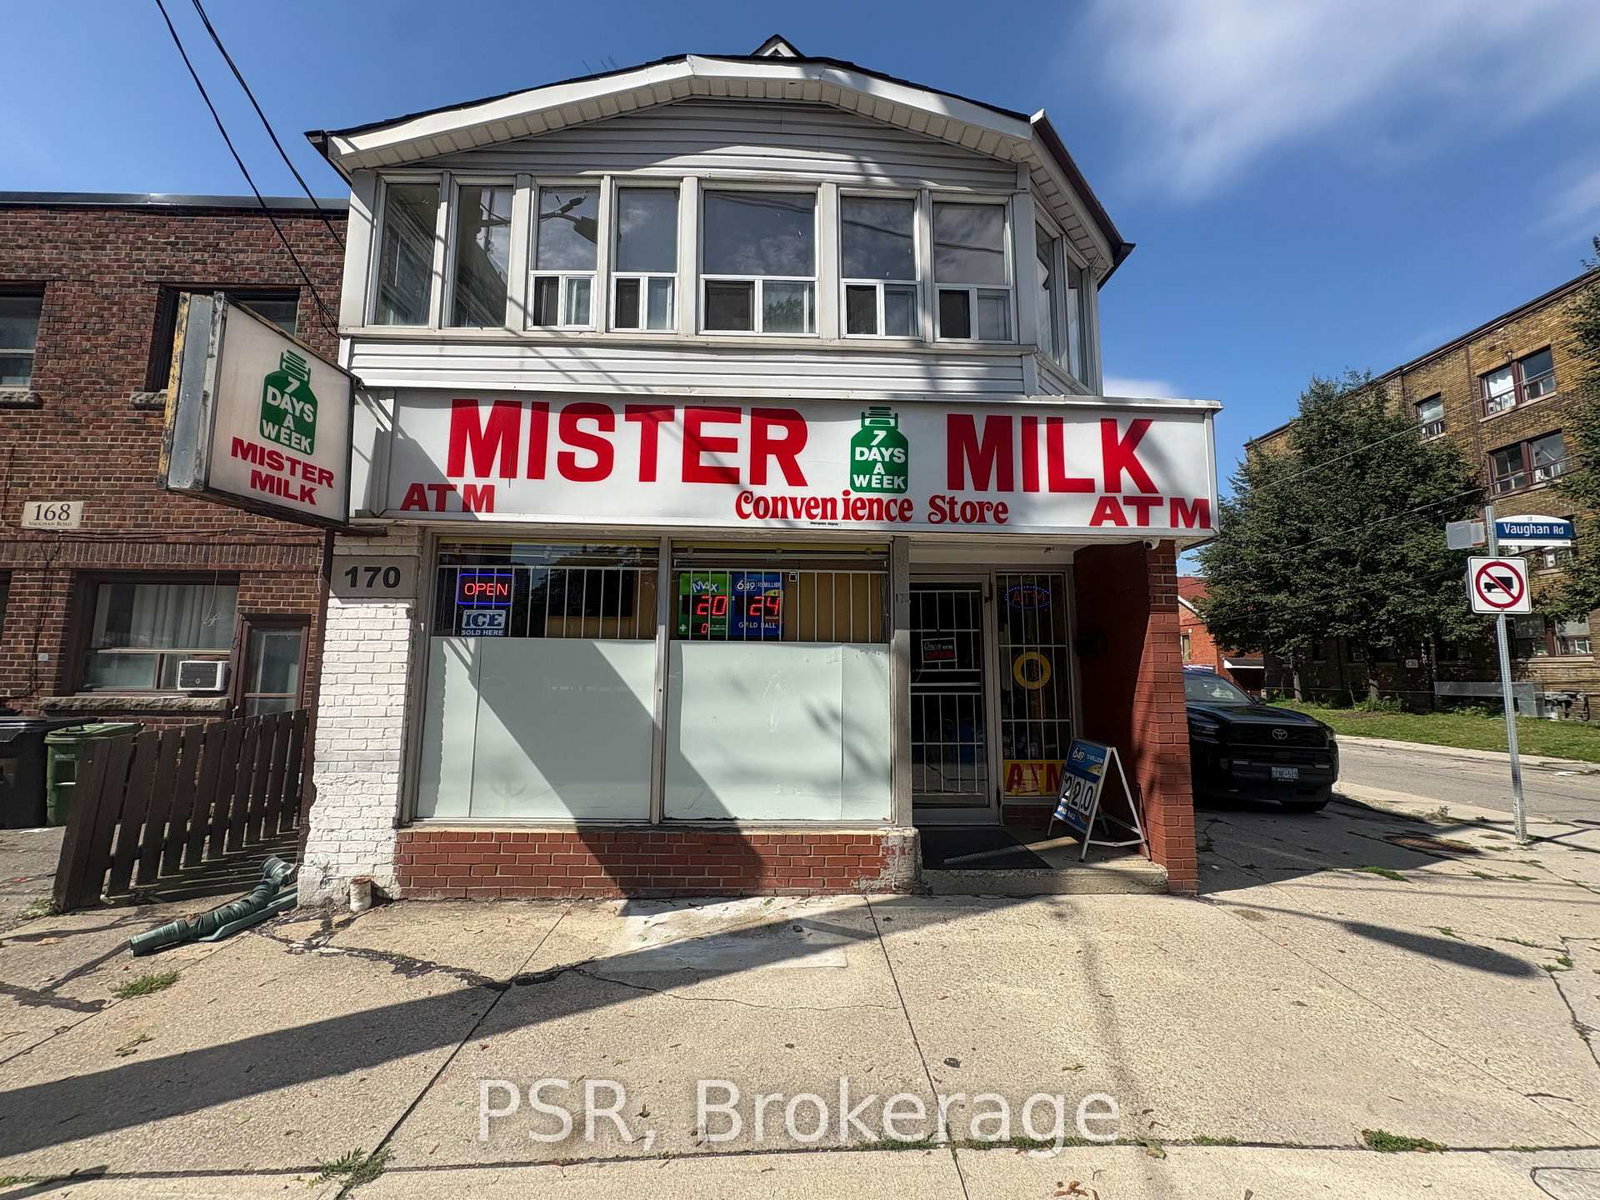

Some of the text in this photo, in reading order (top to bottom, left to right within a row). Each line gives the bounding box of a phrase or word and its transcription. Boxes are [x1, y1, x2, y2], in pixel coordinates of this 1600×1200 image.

[284, 376, 300, 393] 7
[266, 384, 315, 423] DAYS
[283, 413, 295, 431] A
[262, 419, 312, 454] WEEK
[447, 399, 1159, 494] MISTER MILK
[870, 430, 887, 446] 7
[230, 436, 334, 489] MISTER
[855, 447, 906, 463] DAYS
[873, 462, 885, 475] A
[250, 469, 317, 505] MILK
[853, 474, 906, 489] WEEK
[400, 483, 495, 513] ATM
[735, 489, 1009, 525] Convenience Store
[33, 503, 71, 521] 168
[1089, 496, 1211, 529] ATM
[1504, 523, 1564, 536] Vaughan Rd
[344, 566, 400, 589] 170
[464, 583, 508, 596] OPEN
[695, 595, 728, 615] 20
[749, 596, 781, 616] 24
[464, 613, 503, 627] ICE
